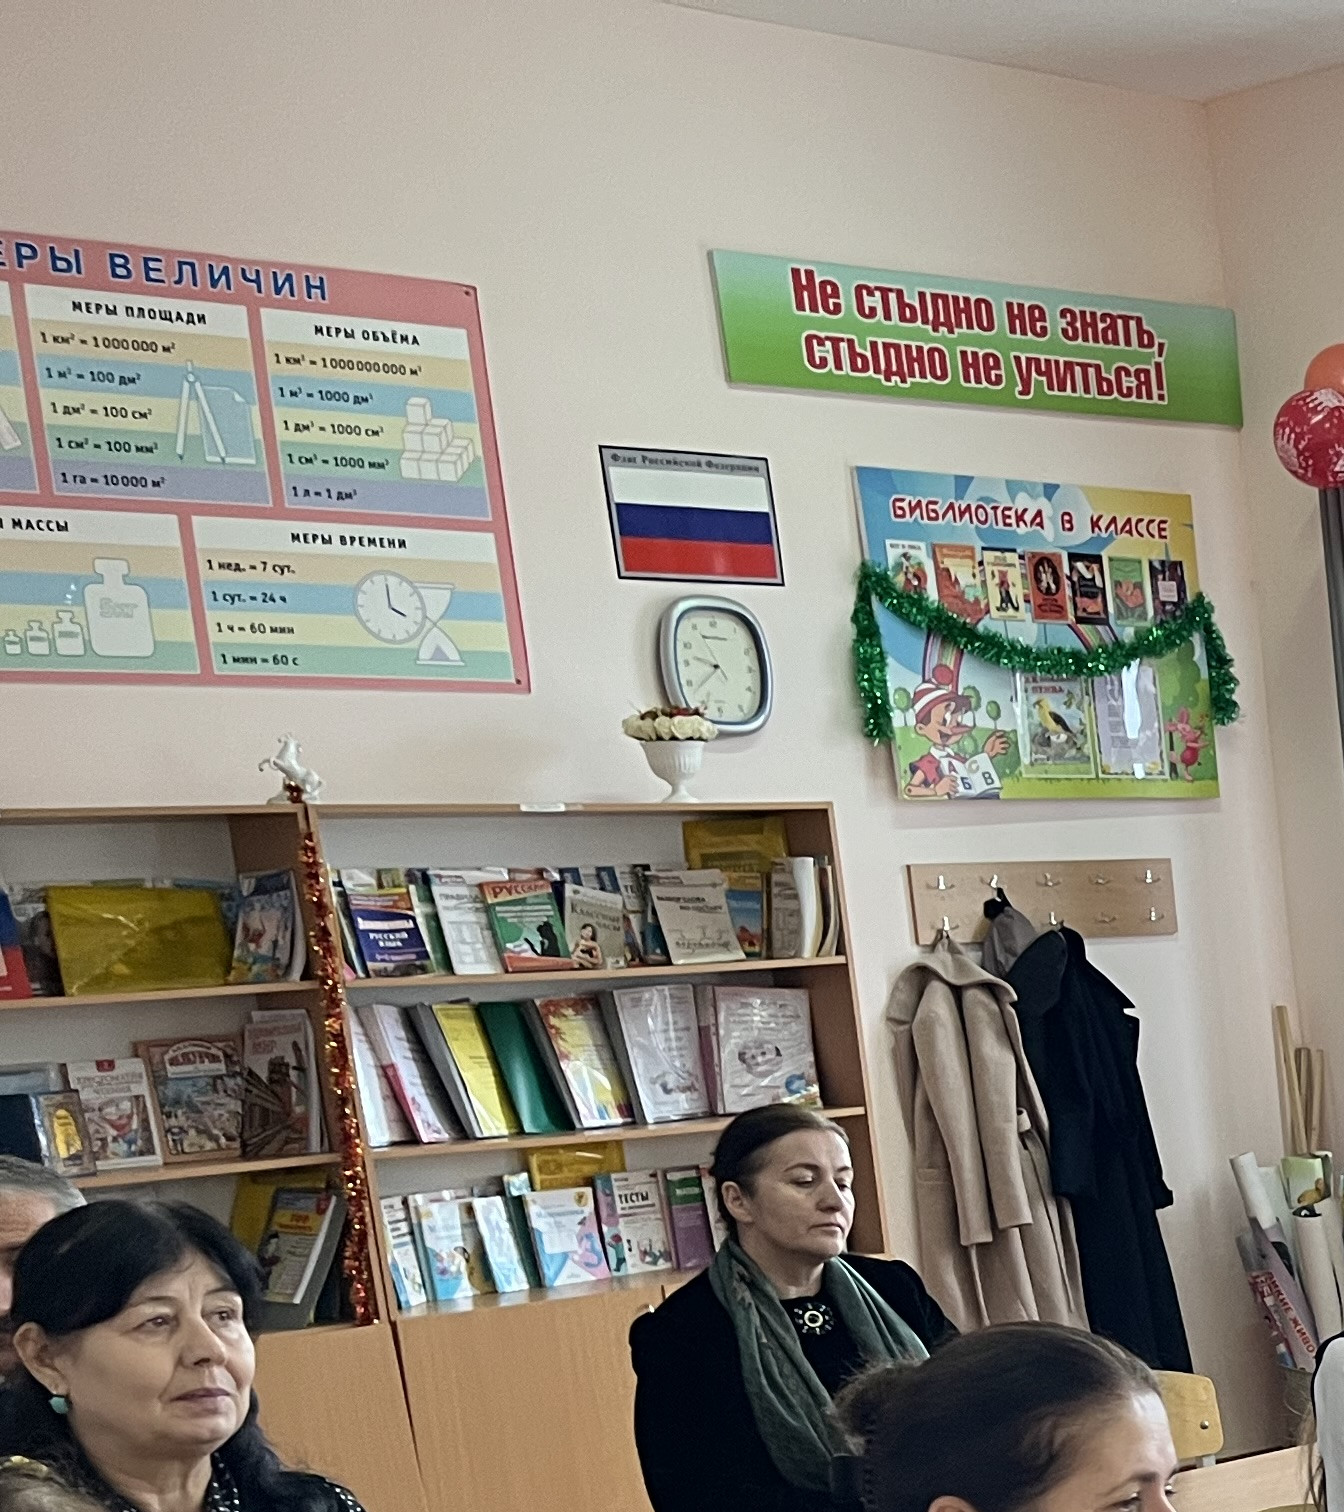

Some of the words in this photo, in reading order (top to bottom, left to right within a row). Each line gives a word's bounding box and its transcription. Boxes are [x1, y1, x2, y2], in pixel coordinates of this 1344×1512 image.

[0, 240, 82, 275] РЫ
[109, 252, 327, 301] ВЕЛИЧИН
[72, 300, 117, 316] МЕРЫ
[125, 305, 207, 326] ПЛОЩАДИ
[790, 266, 842, 316] Не
[855, 282, 995, 334] стыдно
[1005, 302, 1048, 339] не
[1060, 307, 1166, 358] знать,
[314, 325, 355, 340] МЕРЫ
[362, 329, 420, 346] ОБЪЁМА
[804, 334, 949, 385] стыдно
[960, 349, 1003, 388] не
[1013, 354, 1167, 402] учиться!
[12, 518, 69, 532] МАССЫ
[892, 497, 1045, 530] БИБЛИОТЕКА
[1061, 512, 1074, 532] В
[1091, 514, 1169, 540] КЛАССЕ
[291, 532, 332, 545] МЕРЫ
[340, 535, 407, 549] ВРЕМЕНИ
[207, 559, 213, 570] 1
[218, 561, 246, 573] нед.
[260, 561, 268, 572] 7
[272, 563, 296, 575] сут.
[212, 591, 219, 602] 1
[222, 593, 247, 605] сут.
[260, 592, 275, 603] 24
[278, 595, 287, 604] ч
[216, 622, 223, 633] 1
[227, 624, 235, 633] ч
[249, 623, 267, 634] 60
[269, 625, 295, 635] мин
[618, 1190, 650, 1205] ТЕСТЫ
